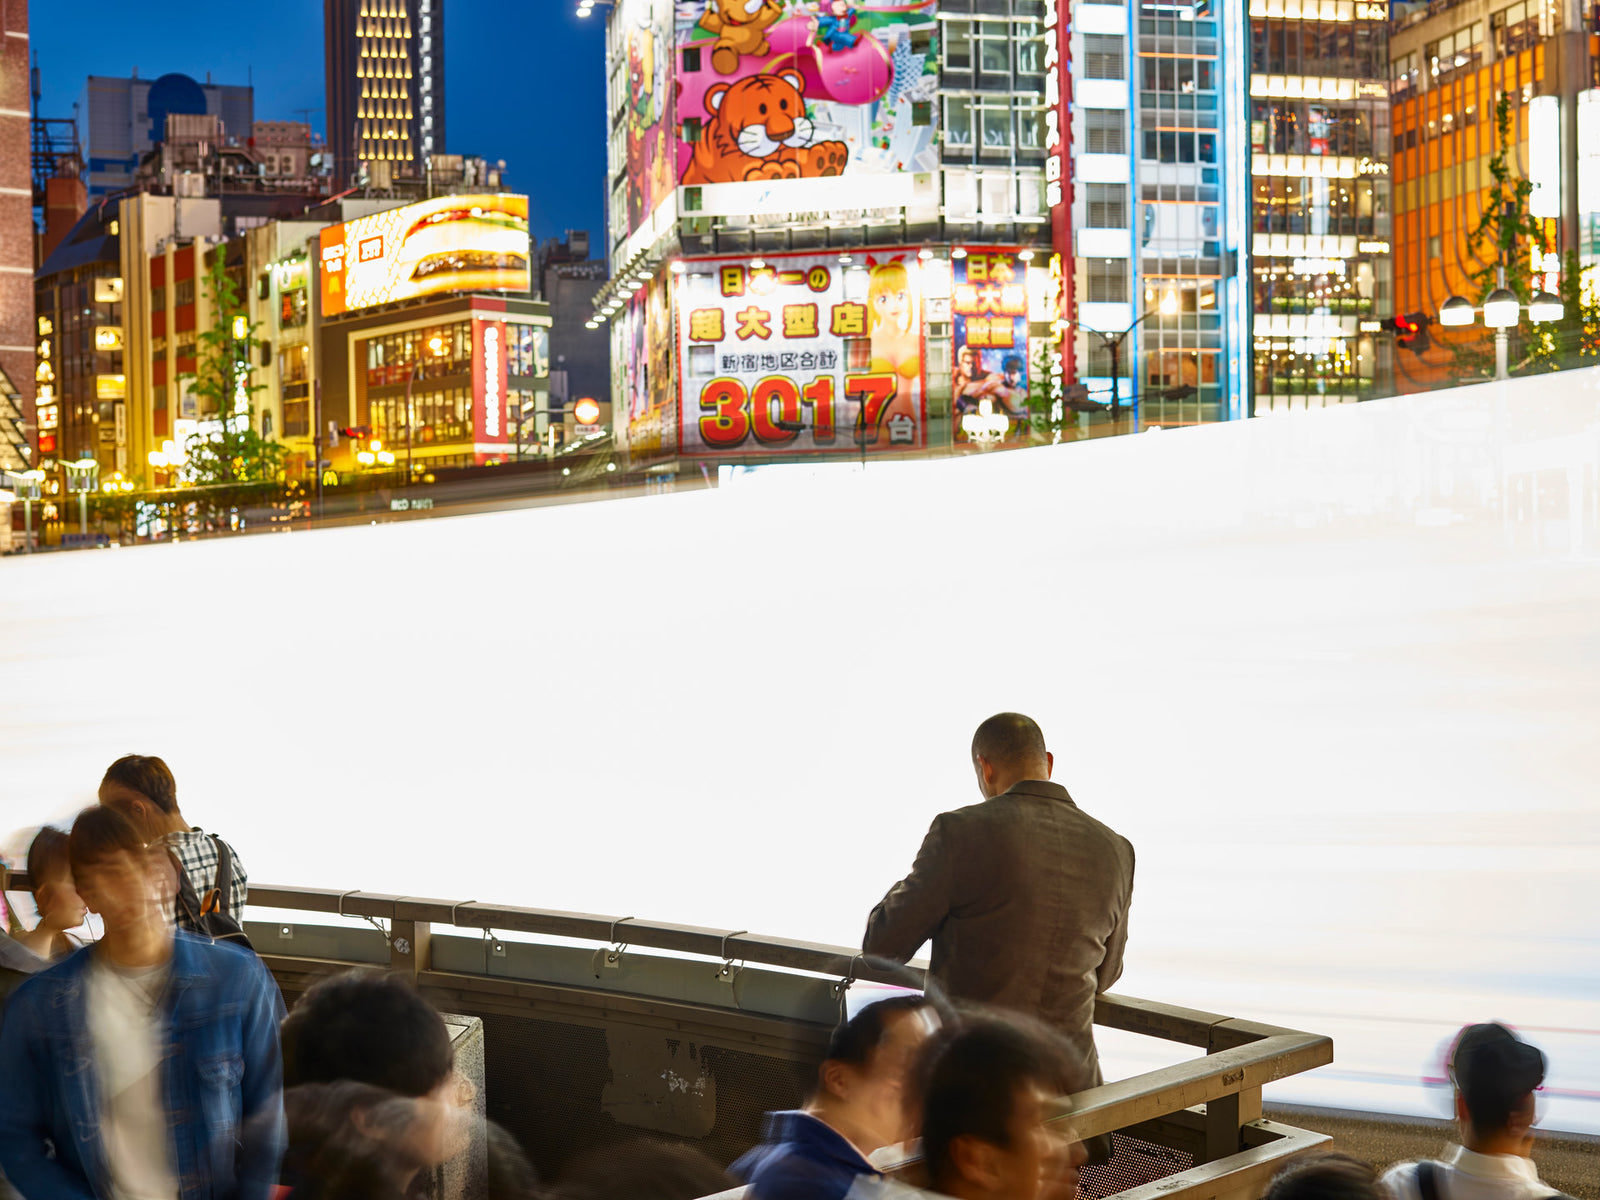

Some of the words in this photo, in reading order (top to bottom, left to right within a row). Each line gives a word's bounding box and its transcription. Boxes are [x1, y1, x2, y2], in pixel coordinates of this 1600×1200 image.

[967, 254, 1015, 281] 日本
[689, 302, 867, 341] 超大型店
[722, 351, 837, 373] 新宿地区合計
